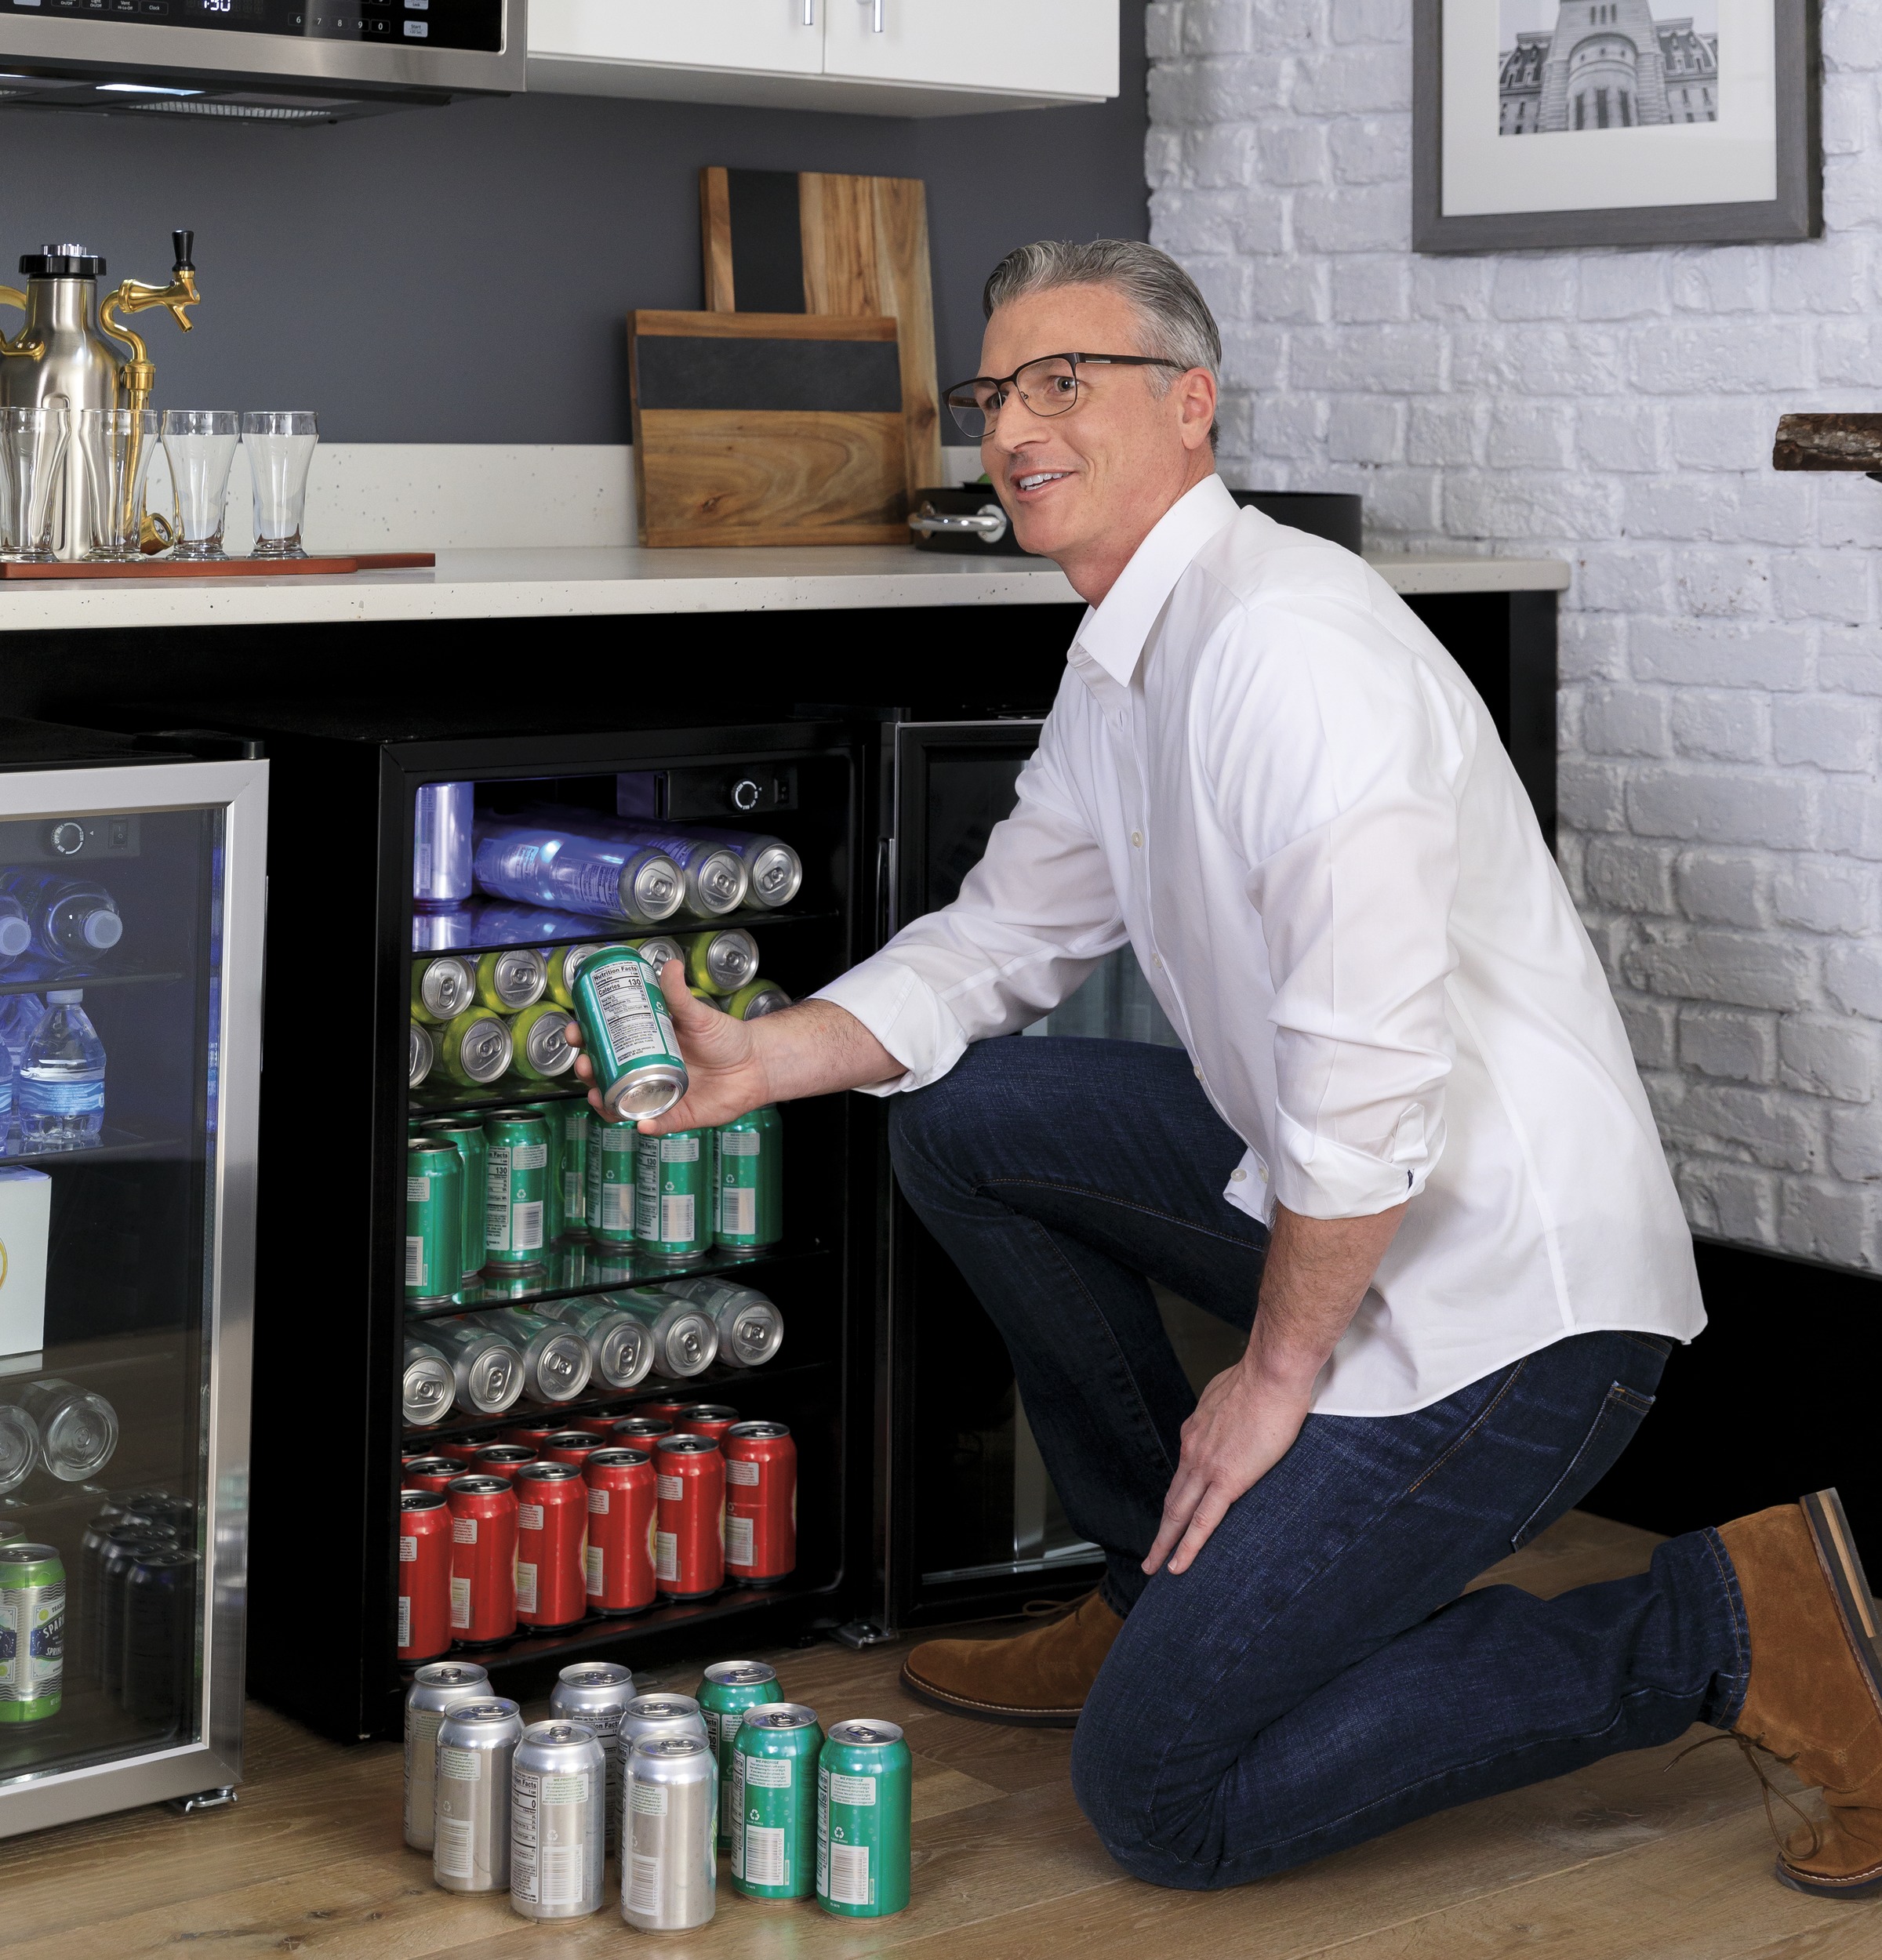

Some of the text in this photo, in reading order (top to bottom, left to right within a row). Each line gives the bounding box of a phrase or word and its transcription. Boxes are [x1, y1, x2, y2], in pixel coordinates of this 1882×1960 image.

[594, 968, 620, 981] Nutrition
[598, 984, 620, 996] Calories
[522, 1780, 537, 1788] Facts
[532, 1800, 536, 1808] 0
